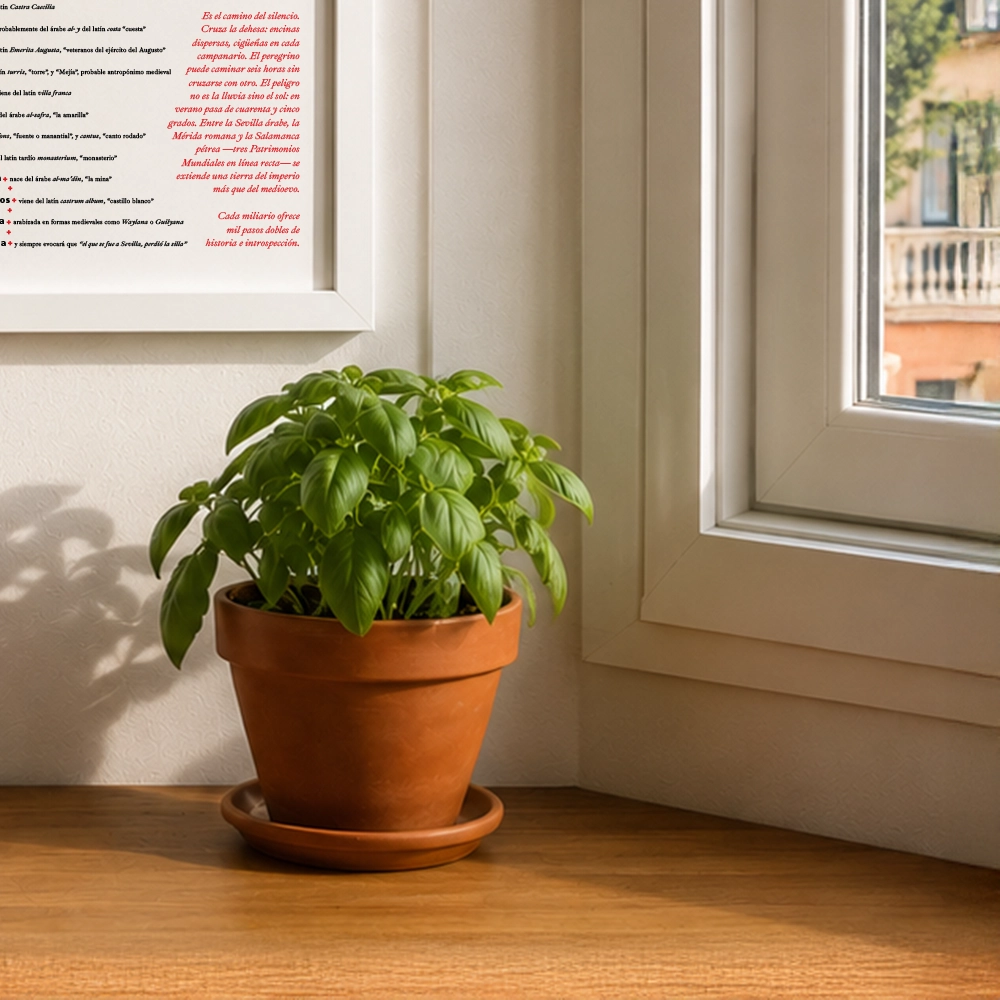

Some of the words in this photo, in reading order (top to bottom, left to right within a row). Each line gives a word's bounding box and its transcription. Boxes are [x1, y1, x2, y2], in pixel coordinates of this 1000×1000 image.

[217, 212, 240, 220] Cada
[242, 212, 275, 220] miliario
[277, 212, 300, 222] ofrece
[241, 228, 264, 236] pasos
[266, 226, 289, 234] dobles
[245, 239, 299, 249] introspección.
